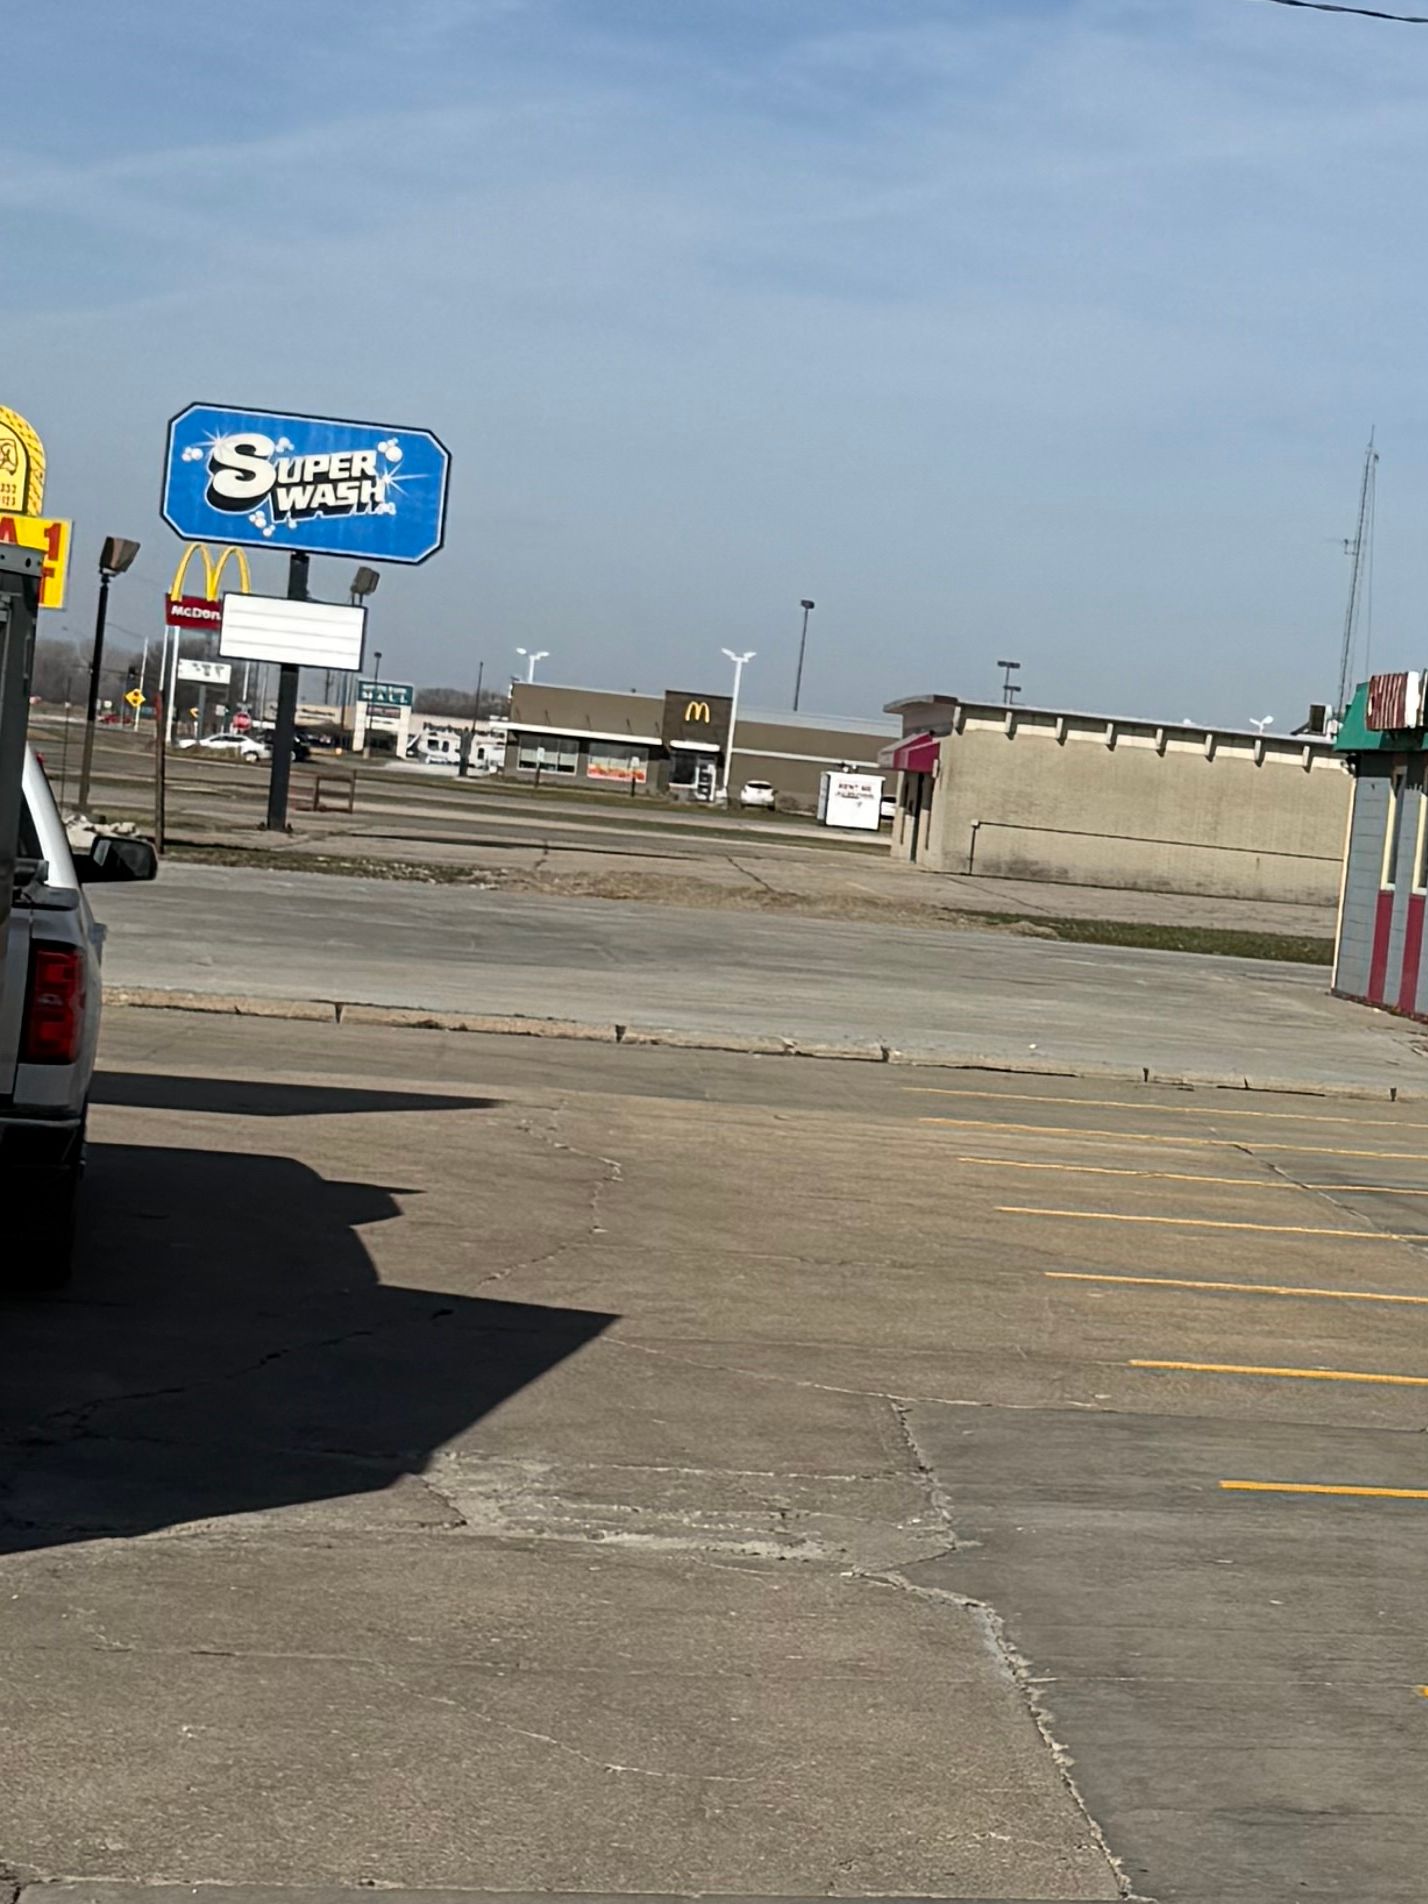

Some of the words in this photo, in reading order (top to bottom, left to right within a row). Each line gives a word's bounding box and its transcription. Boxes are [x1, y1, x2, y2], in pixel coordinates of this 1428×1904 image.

[210, 433, 377, 504] SUPER
[276, 479, 386, 512] WASH
[171, 604, 221, 620] McDon
